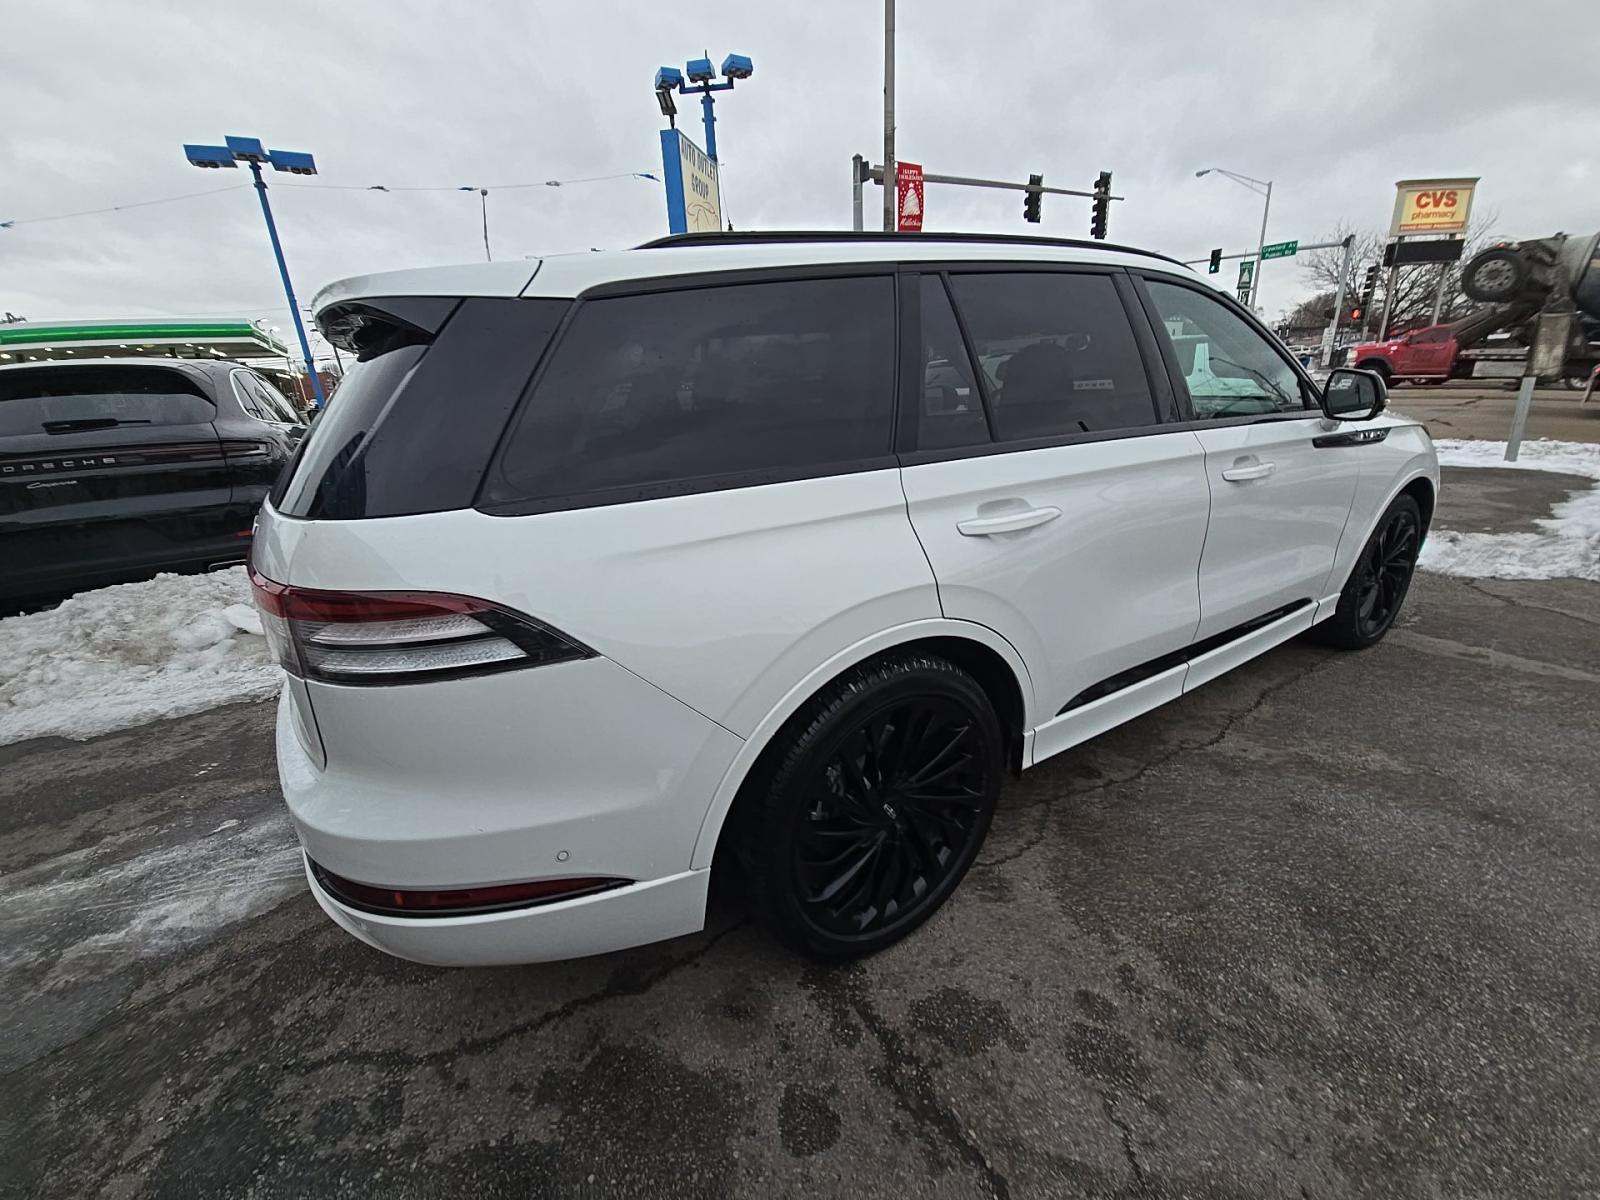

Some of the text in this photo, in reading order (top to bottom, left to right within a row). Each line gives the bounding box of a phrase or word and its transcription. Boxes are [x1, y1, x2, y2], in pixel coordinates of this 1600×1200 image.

[1416, 190, 1458, 209] CVS
[1411, 210, 1457, 221] pharmacy
[2, 457, 116, 473] ORSCHE
